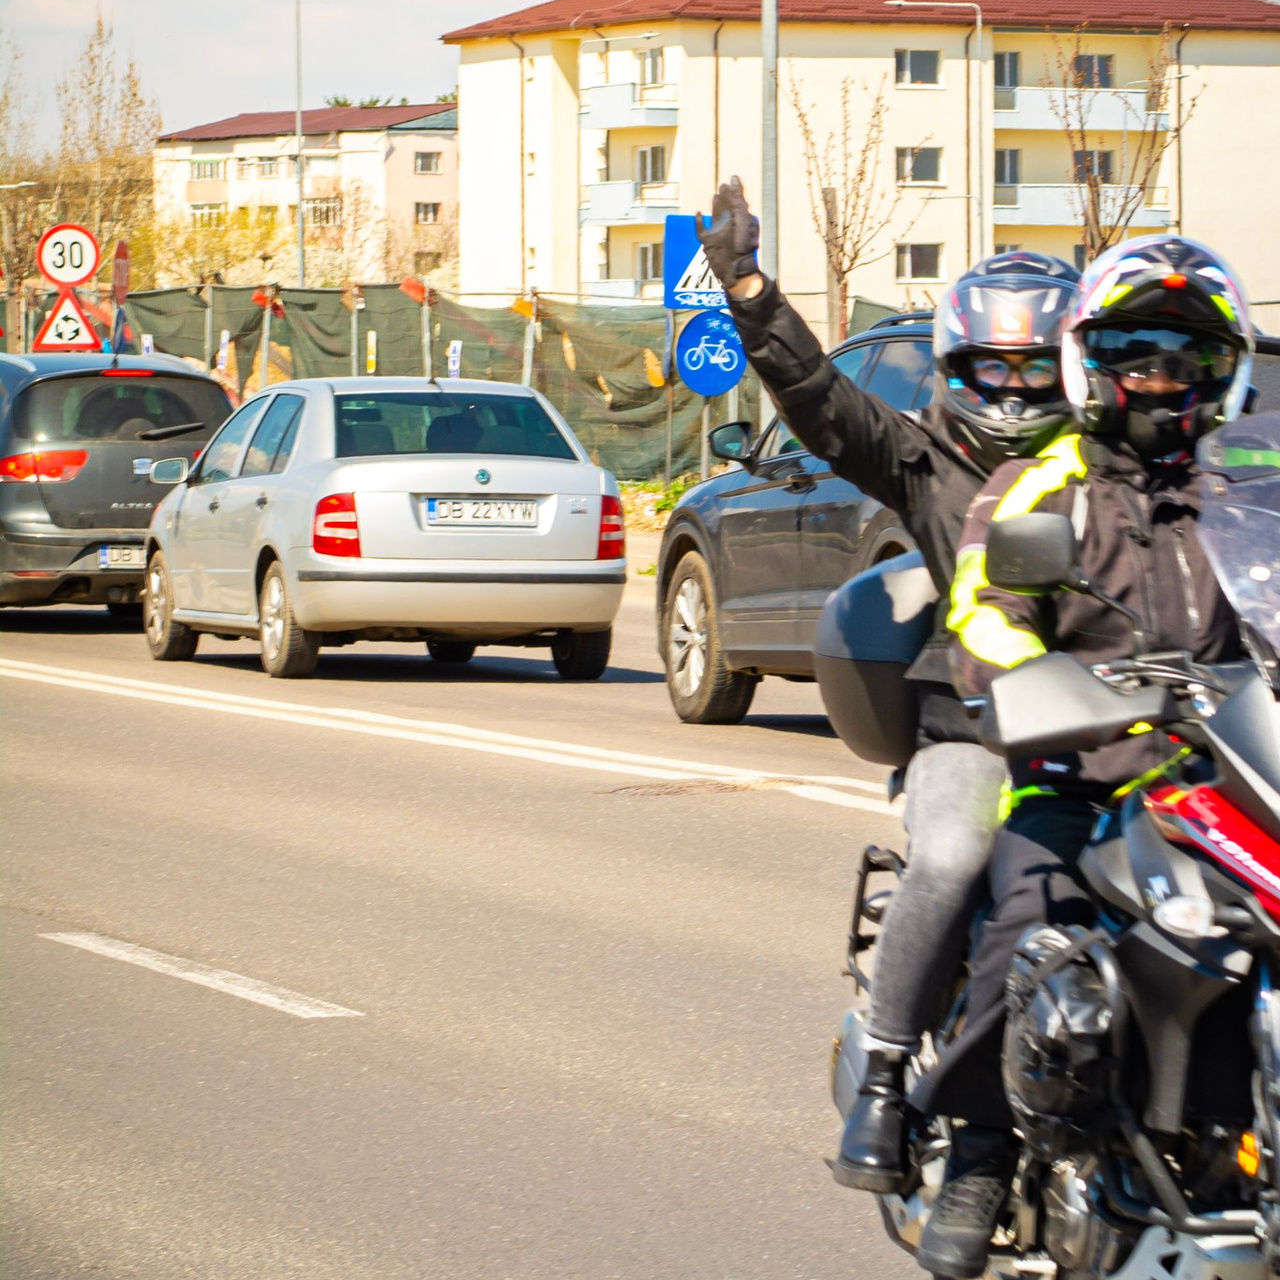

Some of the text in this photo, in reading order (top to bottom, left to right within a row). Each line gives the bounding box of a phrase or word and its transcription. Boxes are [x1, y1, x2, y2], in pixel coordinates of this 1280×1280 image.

[52, 241, 83, 269] 30
[438, 501, 463, 519] DB
[110, 547, 133, 562] DB
